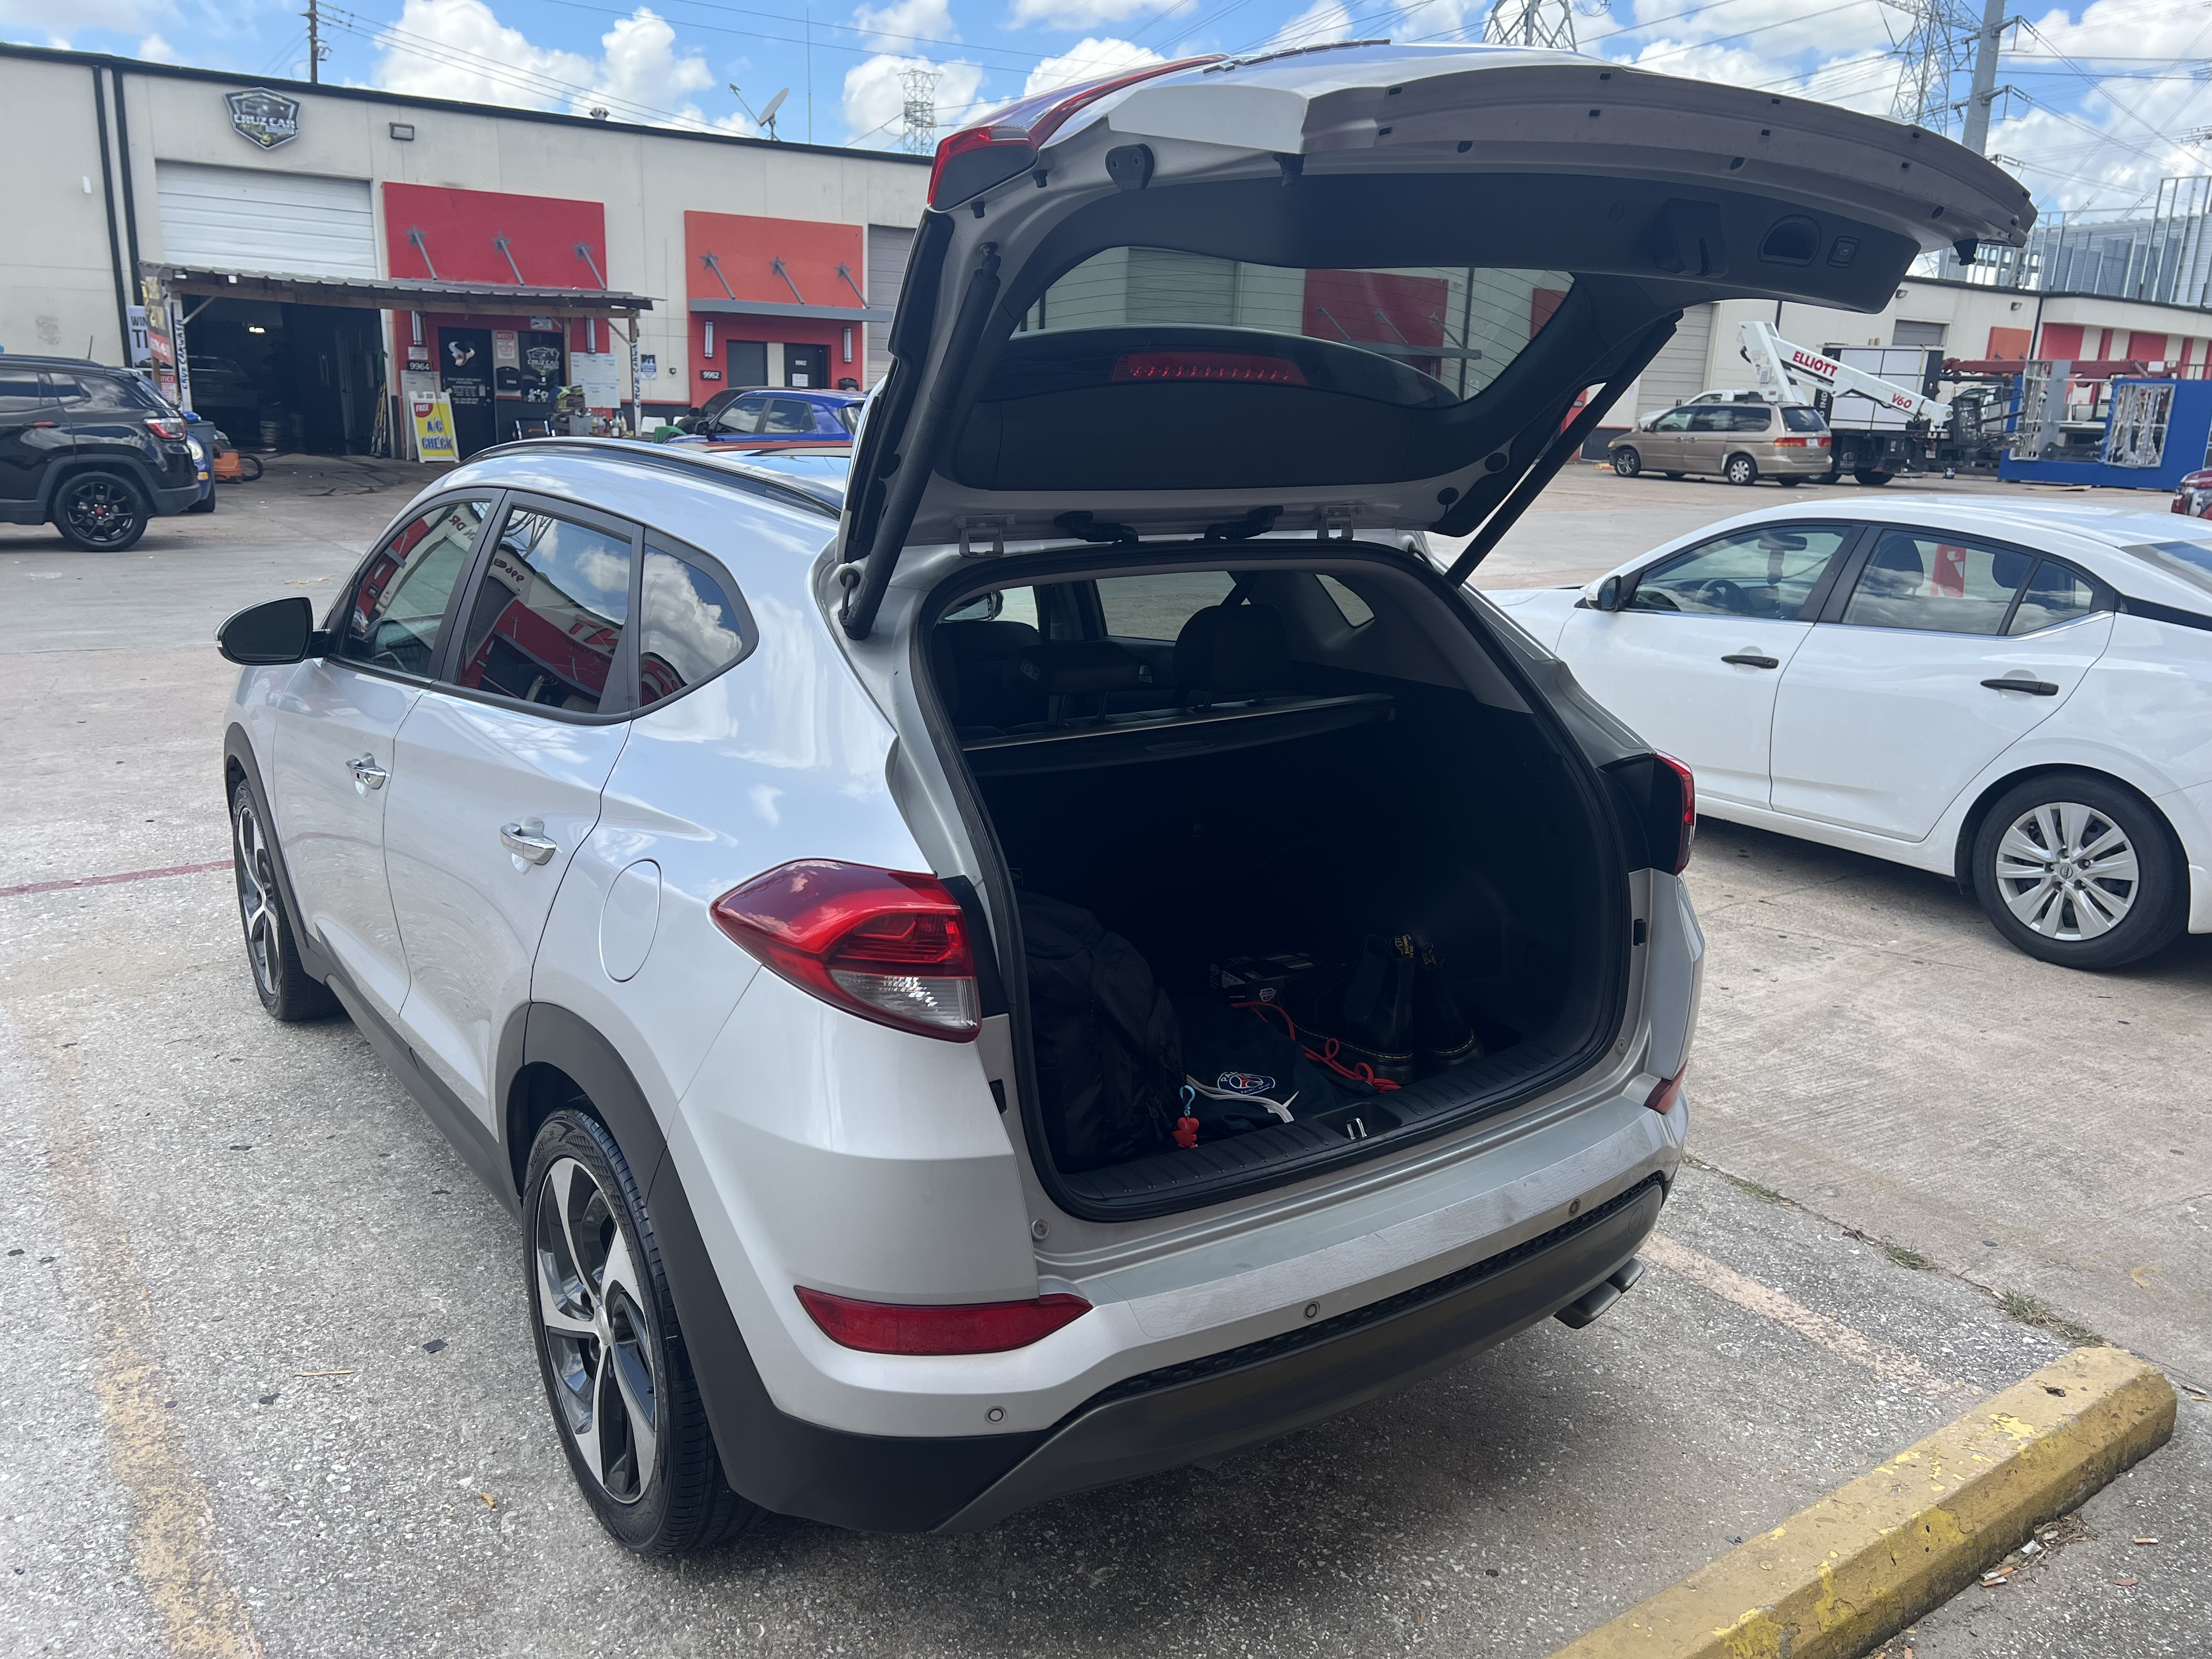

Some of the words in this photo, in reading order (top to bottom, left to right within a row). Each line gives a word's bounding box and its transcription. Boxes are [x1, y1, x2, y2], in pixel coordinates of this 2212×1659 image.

[233, 113, 268, 126] CRUZ
[269, 117, 295, 128] CAR
[131, 315, 147, 326] WIN
[132, 329, 148, 348] TI
[409, 362, 430, 370] 9964
[1792, 351, 1838, 376] ELLIOTT
[415, 404, 430, 412] FREE
[1892, 393, 1912, 408] V60
[427, 418, 443, 433] A/C
[421, 436, 453, 449] CHECK
